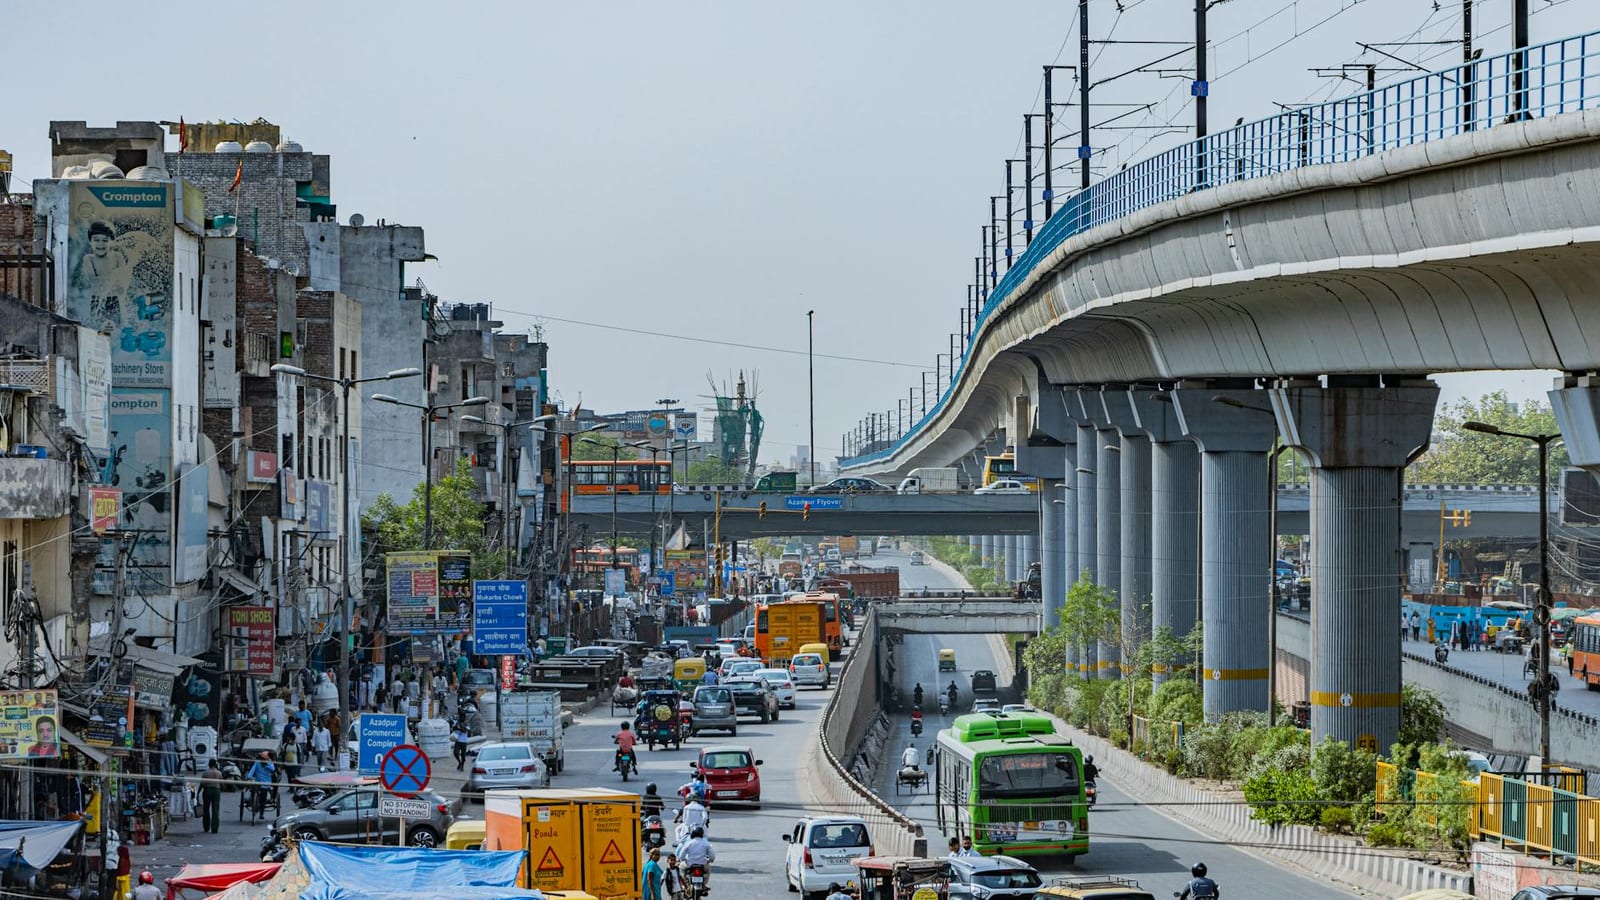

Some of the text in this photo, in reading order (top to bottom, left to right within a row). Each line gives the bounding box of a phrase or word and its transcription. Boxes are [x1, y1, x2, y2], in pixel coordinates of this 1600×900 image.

[102, 191, 162, 203] Crompton
[111, 362, 164, 376] achinery Store
[111, 400, 158, 410] ompton
[816, 498, 841, 507] Flyover
[249, 610, 272, 624] SHOES
[484, 642, 509, 650] Shalimar
[368, 718, 398, 728] Azadpur
[362, 728, 403, 737] Commercial
[367, 738, 397, 749] Complex
[394, 808, 427, 816] STANDING
